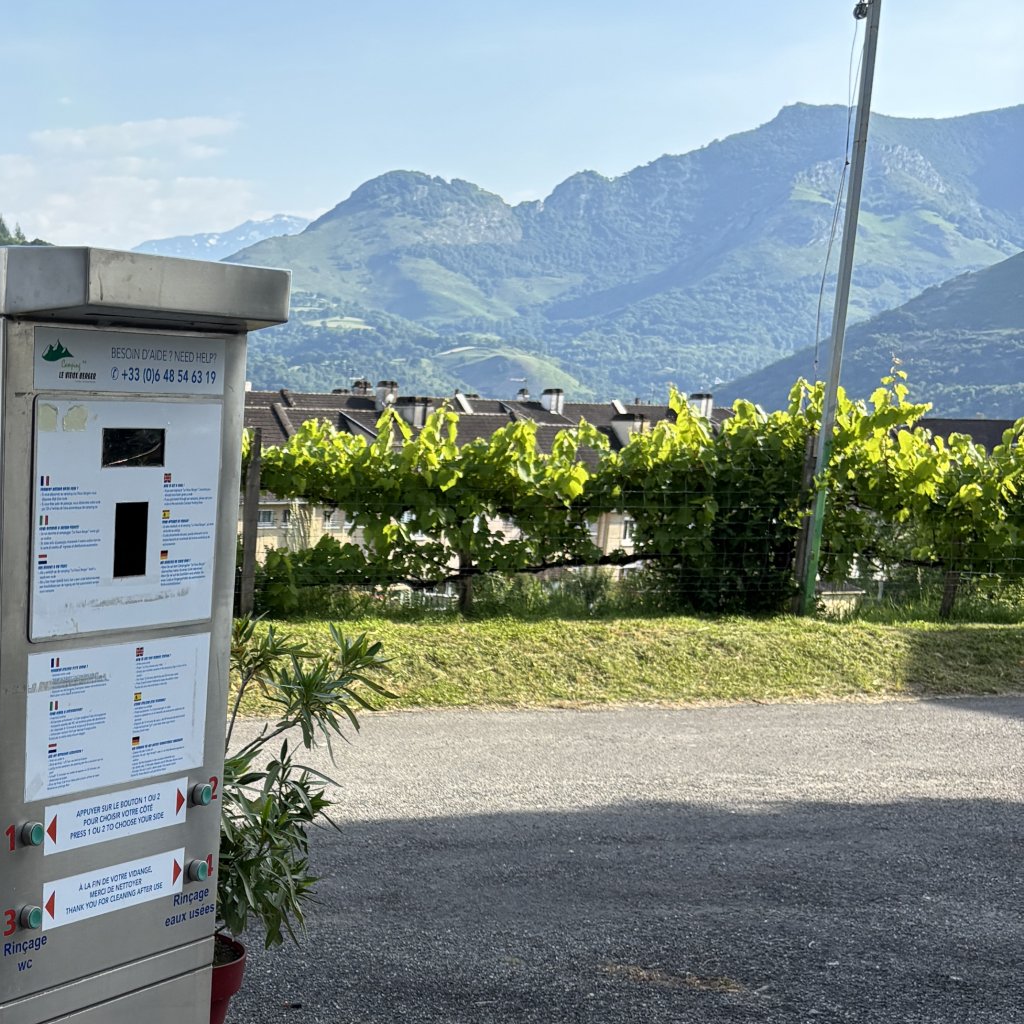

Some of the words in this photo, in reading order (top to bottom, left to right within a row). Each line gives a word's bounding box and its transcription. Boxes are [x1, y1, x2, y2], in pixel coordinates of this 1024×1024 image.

[111, 347, 140, 360] BESOIN
[142, 349, 167, 361] D'AIDE
[168, 350, 173, 362] ?
[175, 351, 194, 363] NEED
[196, 351, 217, 364] HELP?
[121, 369, 140, 382] +33
[143, 369, 161, 384] (0)6
[163, 369, 175, 383] 48
[177, 370, 189, 383] 54
[191, 370, 202, 384] 63
[206, 371, 216, 385] 19
[209, 776, 219, 800] 2
[76, 806, 101, 818] APPUYER
[101, 804, 113, 812] SUR
[113, 801, 120, 810] LE
[120, 797, 143, 809] BOUTON
[147, 794, 157, 802] OU
[83, 816, 99, 827] POUR
[99, 811, 121, 823] CHOISIR
[121, 807, 139, 818] VOTRE
[70, 829, 87, 840] PRESS
[92, 826, 101, 835] OU
[101, 825, 106, 833] 2
[106, 823, 114, 832] TO
[115, 817, 137, 830] CHOOSE
[137, 814, 153, 824] YOUR
[153, 811, 165, 821] SIDE
[5, 824, 16, 851] 1
[84, 882, 92, 890] LA
[92, 879, 102, 888] FIN
[102, 876, 110, 885] DE
[110, 872, 128, 883] VOTRE
[89, 888, 107, 899] MERCI
[107, 885, 115, 894] DE
[115, 878, 143, 891] NETTOYER
[65, 903, 85, 915] THANK
[85, 900, 98, 910] YOU
[98, 896, 109, 906] FOR
[109, 889, 136, 903] CLEANING
[136, 884, 153, 896] AFTER
[153, 881, 164, 891] USE
[173, 887, 210, 907] Rinçage
[3, 909, 17, 937] 3
[165, 911, 187, 927] eaux
[189, 903, 215, 920] usées
[3, 934, 48, 957] Rinçage
[17, 958, 33, 972] wc
